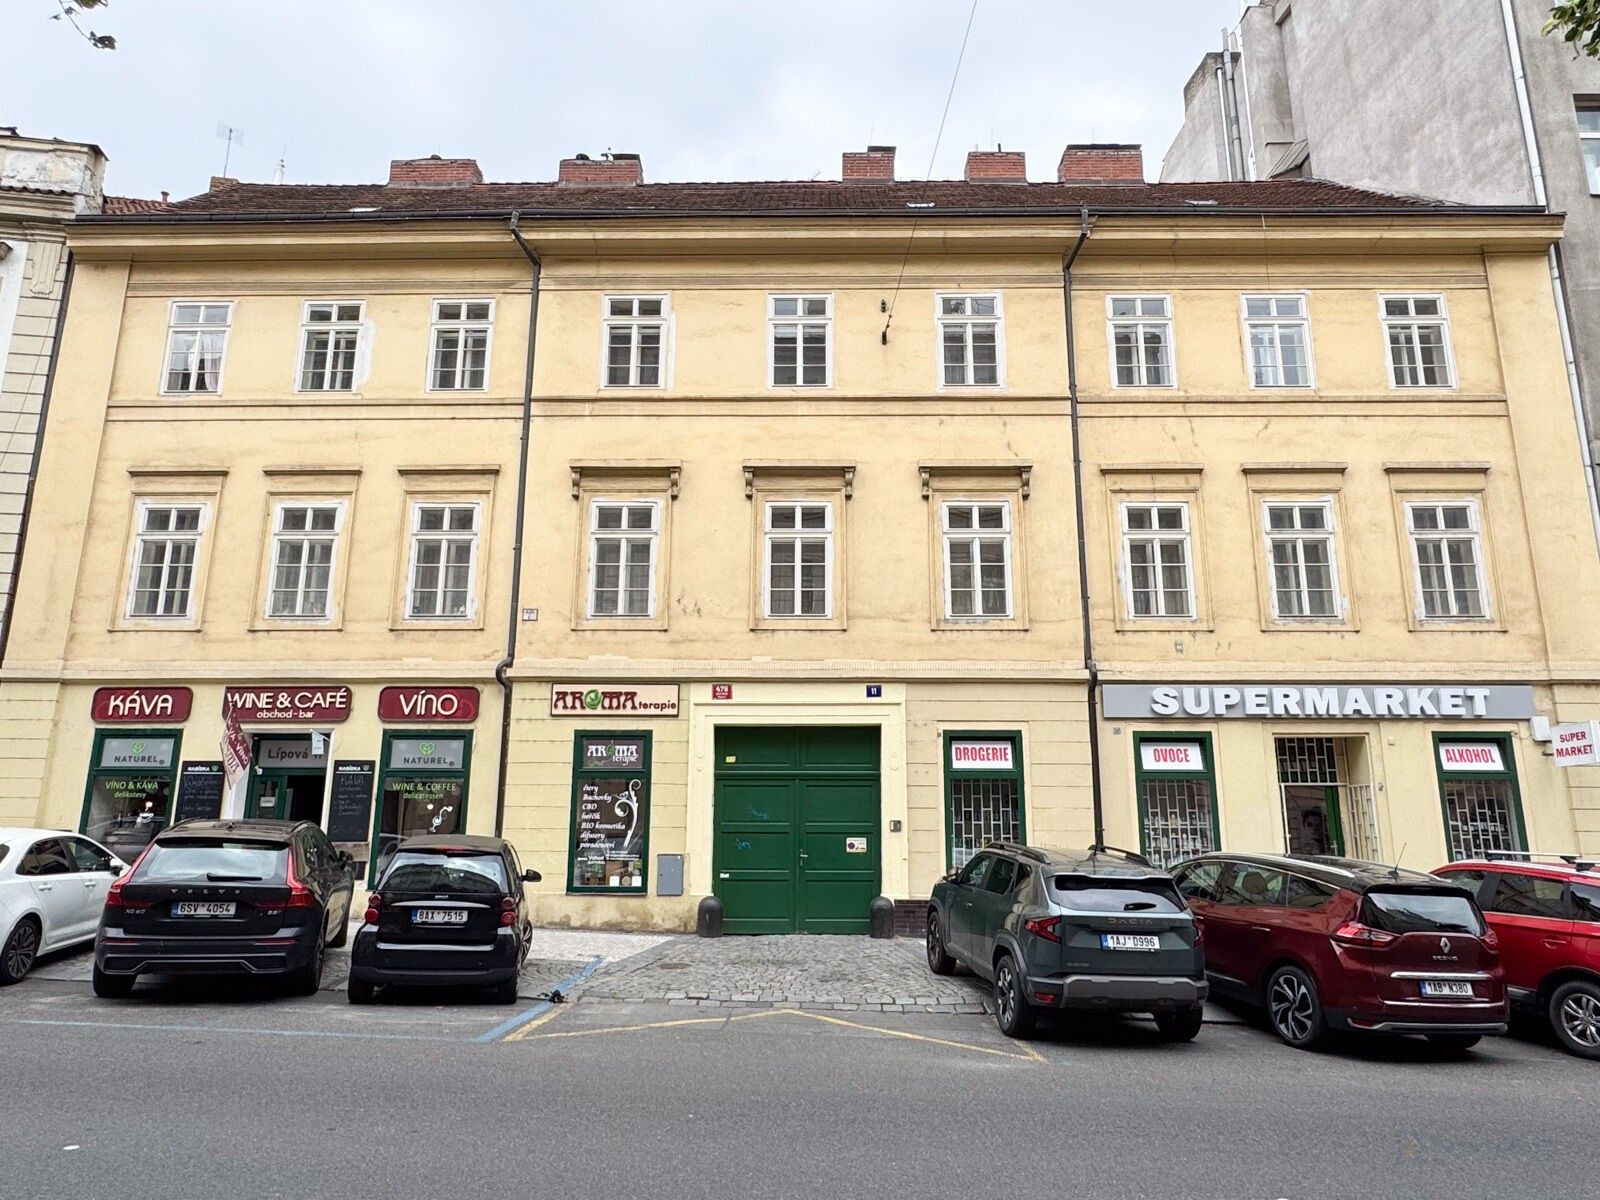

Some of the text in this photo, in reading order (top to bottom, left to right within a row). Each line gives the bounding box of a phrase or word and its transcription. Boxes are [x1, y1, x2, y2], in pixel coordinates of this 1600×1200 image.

[871, 687, 877, 695] 11
[108, 690, 173, 716] KÁVA
[227, 688, 348, 709] WINE & CAFÉ
[553, 688, 677, 712] AROMA terapie
[1151, 686, 1490, 716] SUPERMARKET
[1559, 731, 1587, 743] SUPER
[268, 747, 309, 760] Lípová
[954, 746, 1009, 762] DROGERIE
[1153, 748, 1190, 763] OVOCE
[1445, 748, 1496, 763] ALKOHOL
[1556, 744, 1593, 758] MARKET
[114, 755, 158, 763] NATUREL
[403, 757, 448, 765] NATUREL
[105, 780, 159, 789] VÍNO & KÁVA
[392, 783, 457, 791] WINE & COFFEE
[114, 791, 147, 799] delikatesy
[180, 903, 231, 913] 6SV 4054
[418, 911, 464, 920] 8AX 7515
[1108, 917, 1153, 925] DACIA
[1110, 936, 1156, 947] 1AJ D996
[1427, 982, 1469, 993] 1AB N380
